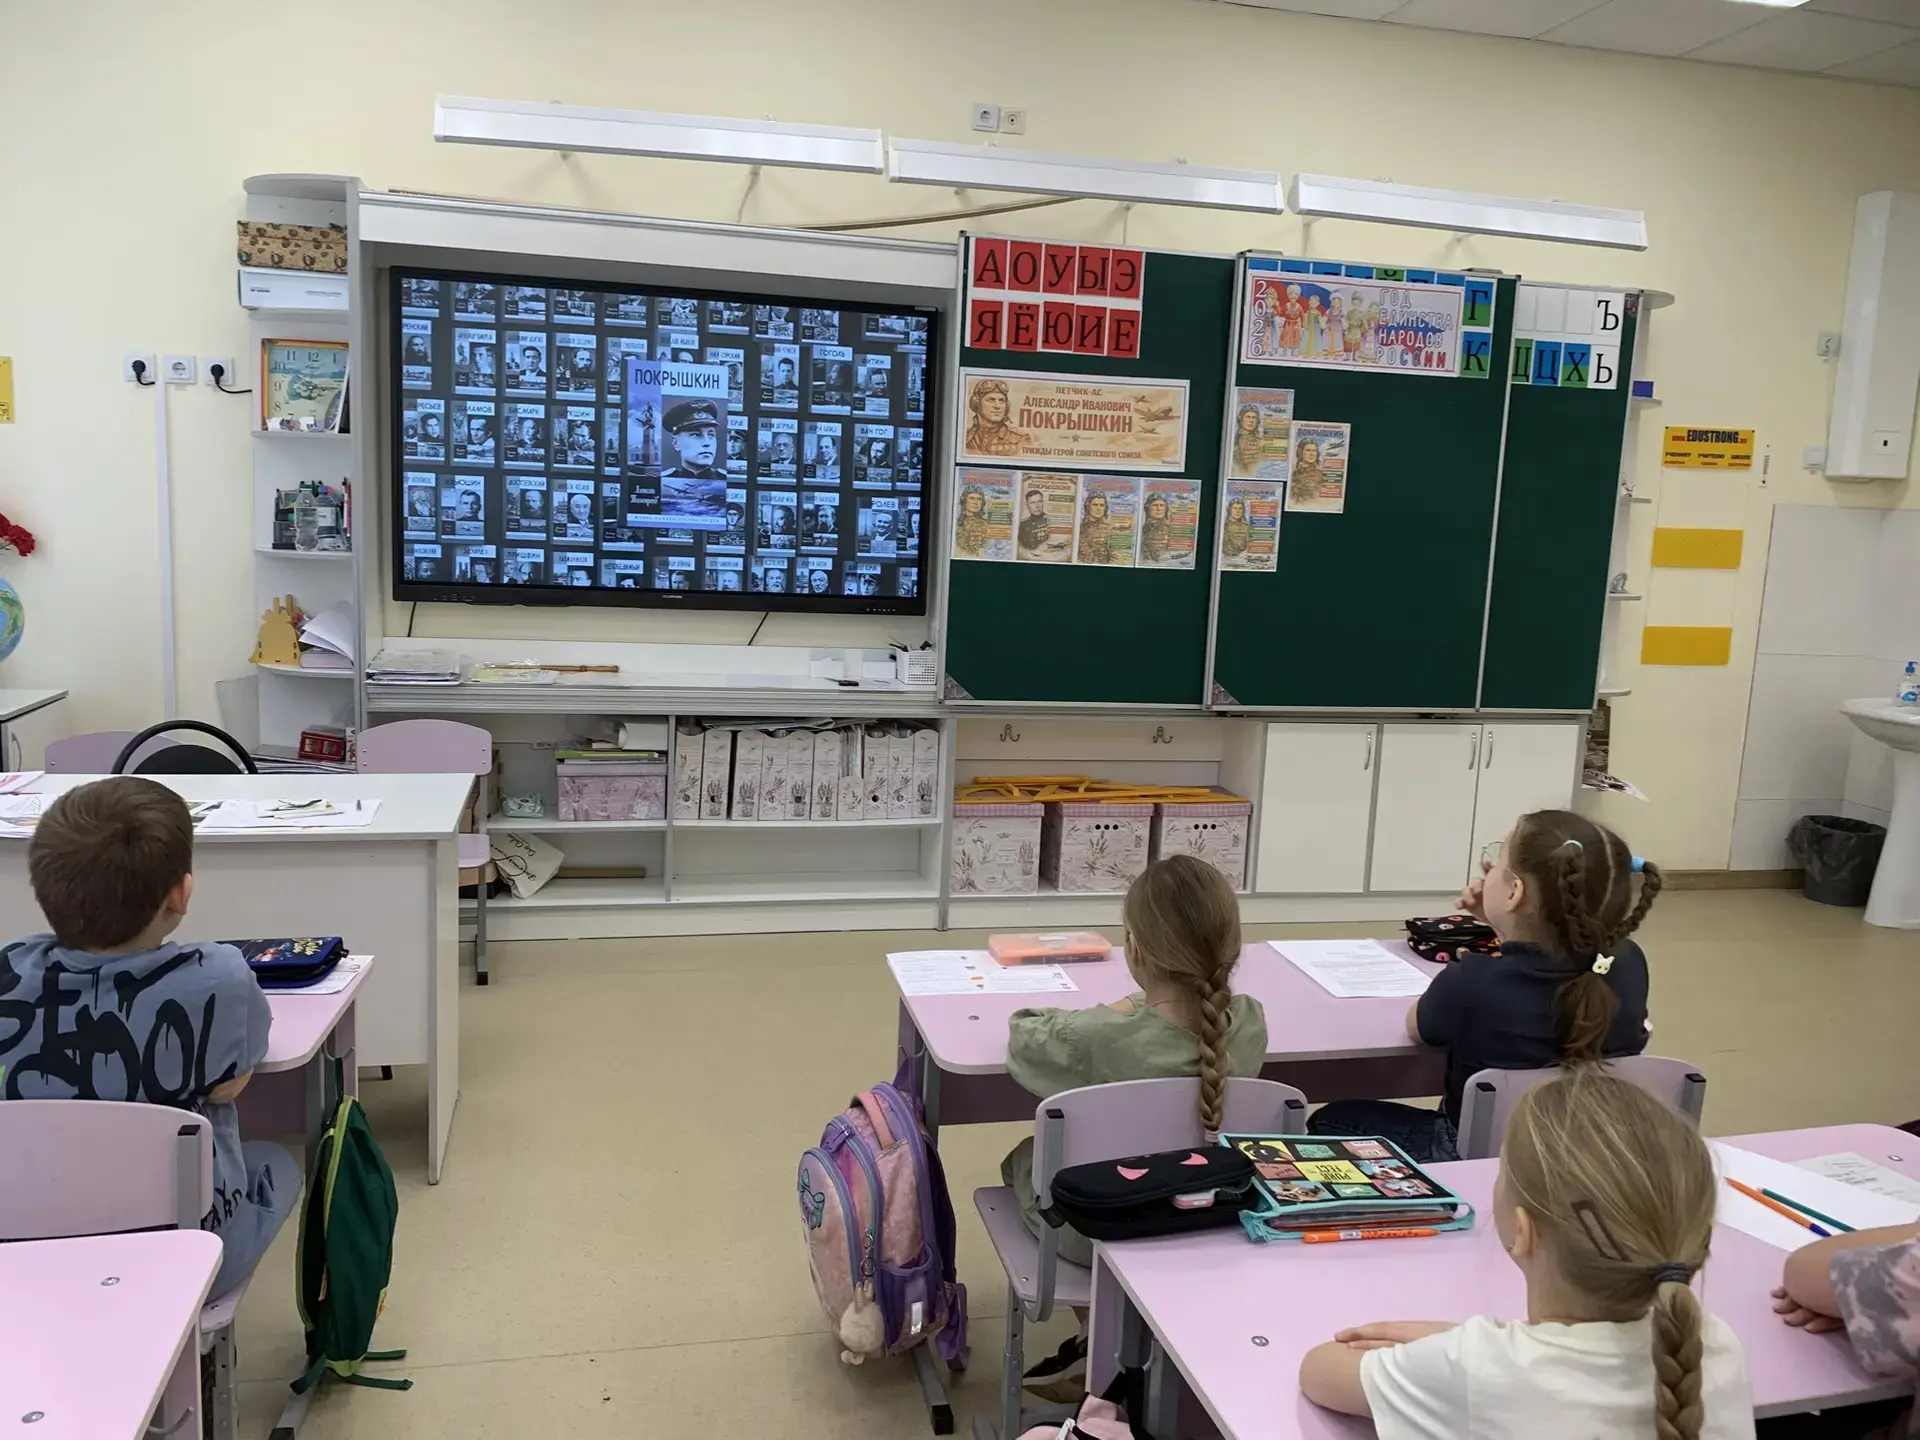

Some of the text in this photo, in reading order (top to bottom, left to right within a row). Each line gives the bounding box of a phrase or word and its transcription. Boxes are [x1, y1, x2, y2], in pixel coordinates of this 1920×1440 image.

[976, 249, 1137, 292] А О У Ы Э
[1379, 288, 1412, 309] ГОД
[1468, 289, 1489, 321] Г
[1250, 280, 1268, 357] 2026
[1378, 309, 1454, 330] ЕДИНСТВА
[1597, 299, 1619, 331] Ъ
[974, 305, 1135, 352] Я Ё Ю И Е
[1377, 330, 1444, 349] НАРОДОВ
[286, 350, 296, 361] 11
[307, 351, 320, 362] 12
[819, 348, 846, 358] ГОГОЛЬ
[1375, 348, 1447, 369] РОССИИ
[1463, 339, 1488, 373] К
[1564, 351, 1587, 382] Х
[1593, 353, 1613, 384] Ь
[274, 382, 282, 392] 9
[634, 369, 720, 389] ПОКРЫШКИН
[273, 402, 282, 412] 8
[1019, 408, 1133, 433] ПОКРЫШКИН
[1687, 430, 1740, 444] EDUSTRONG
